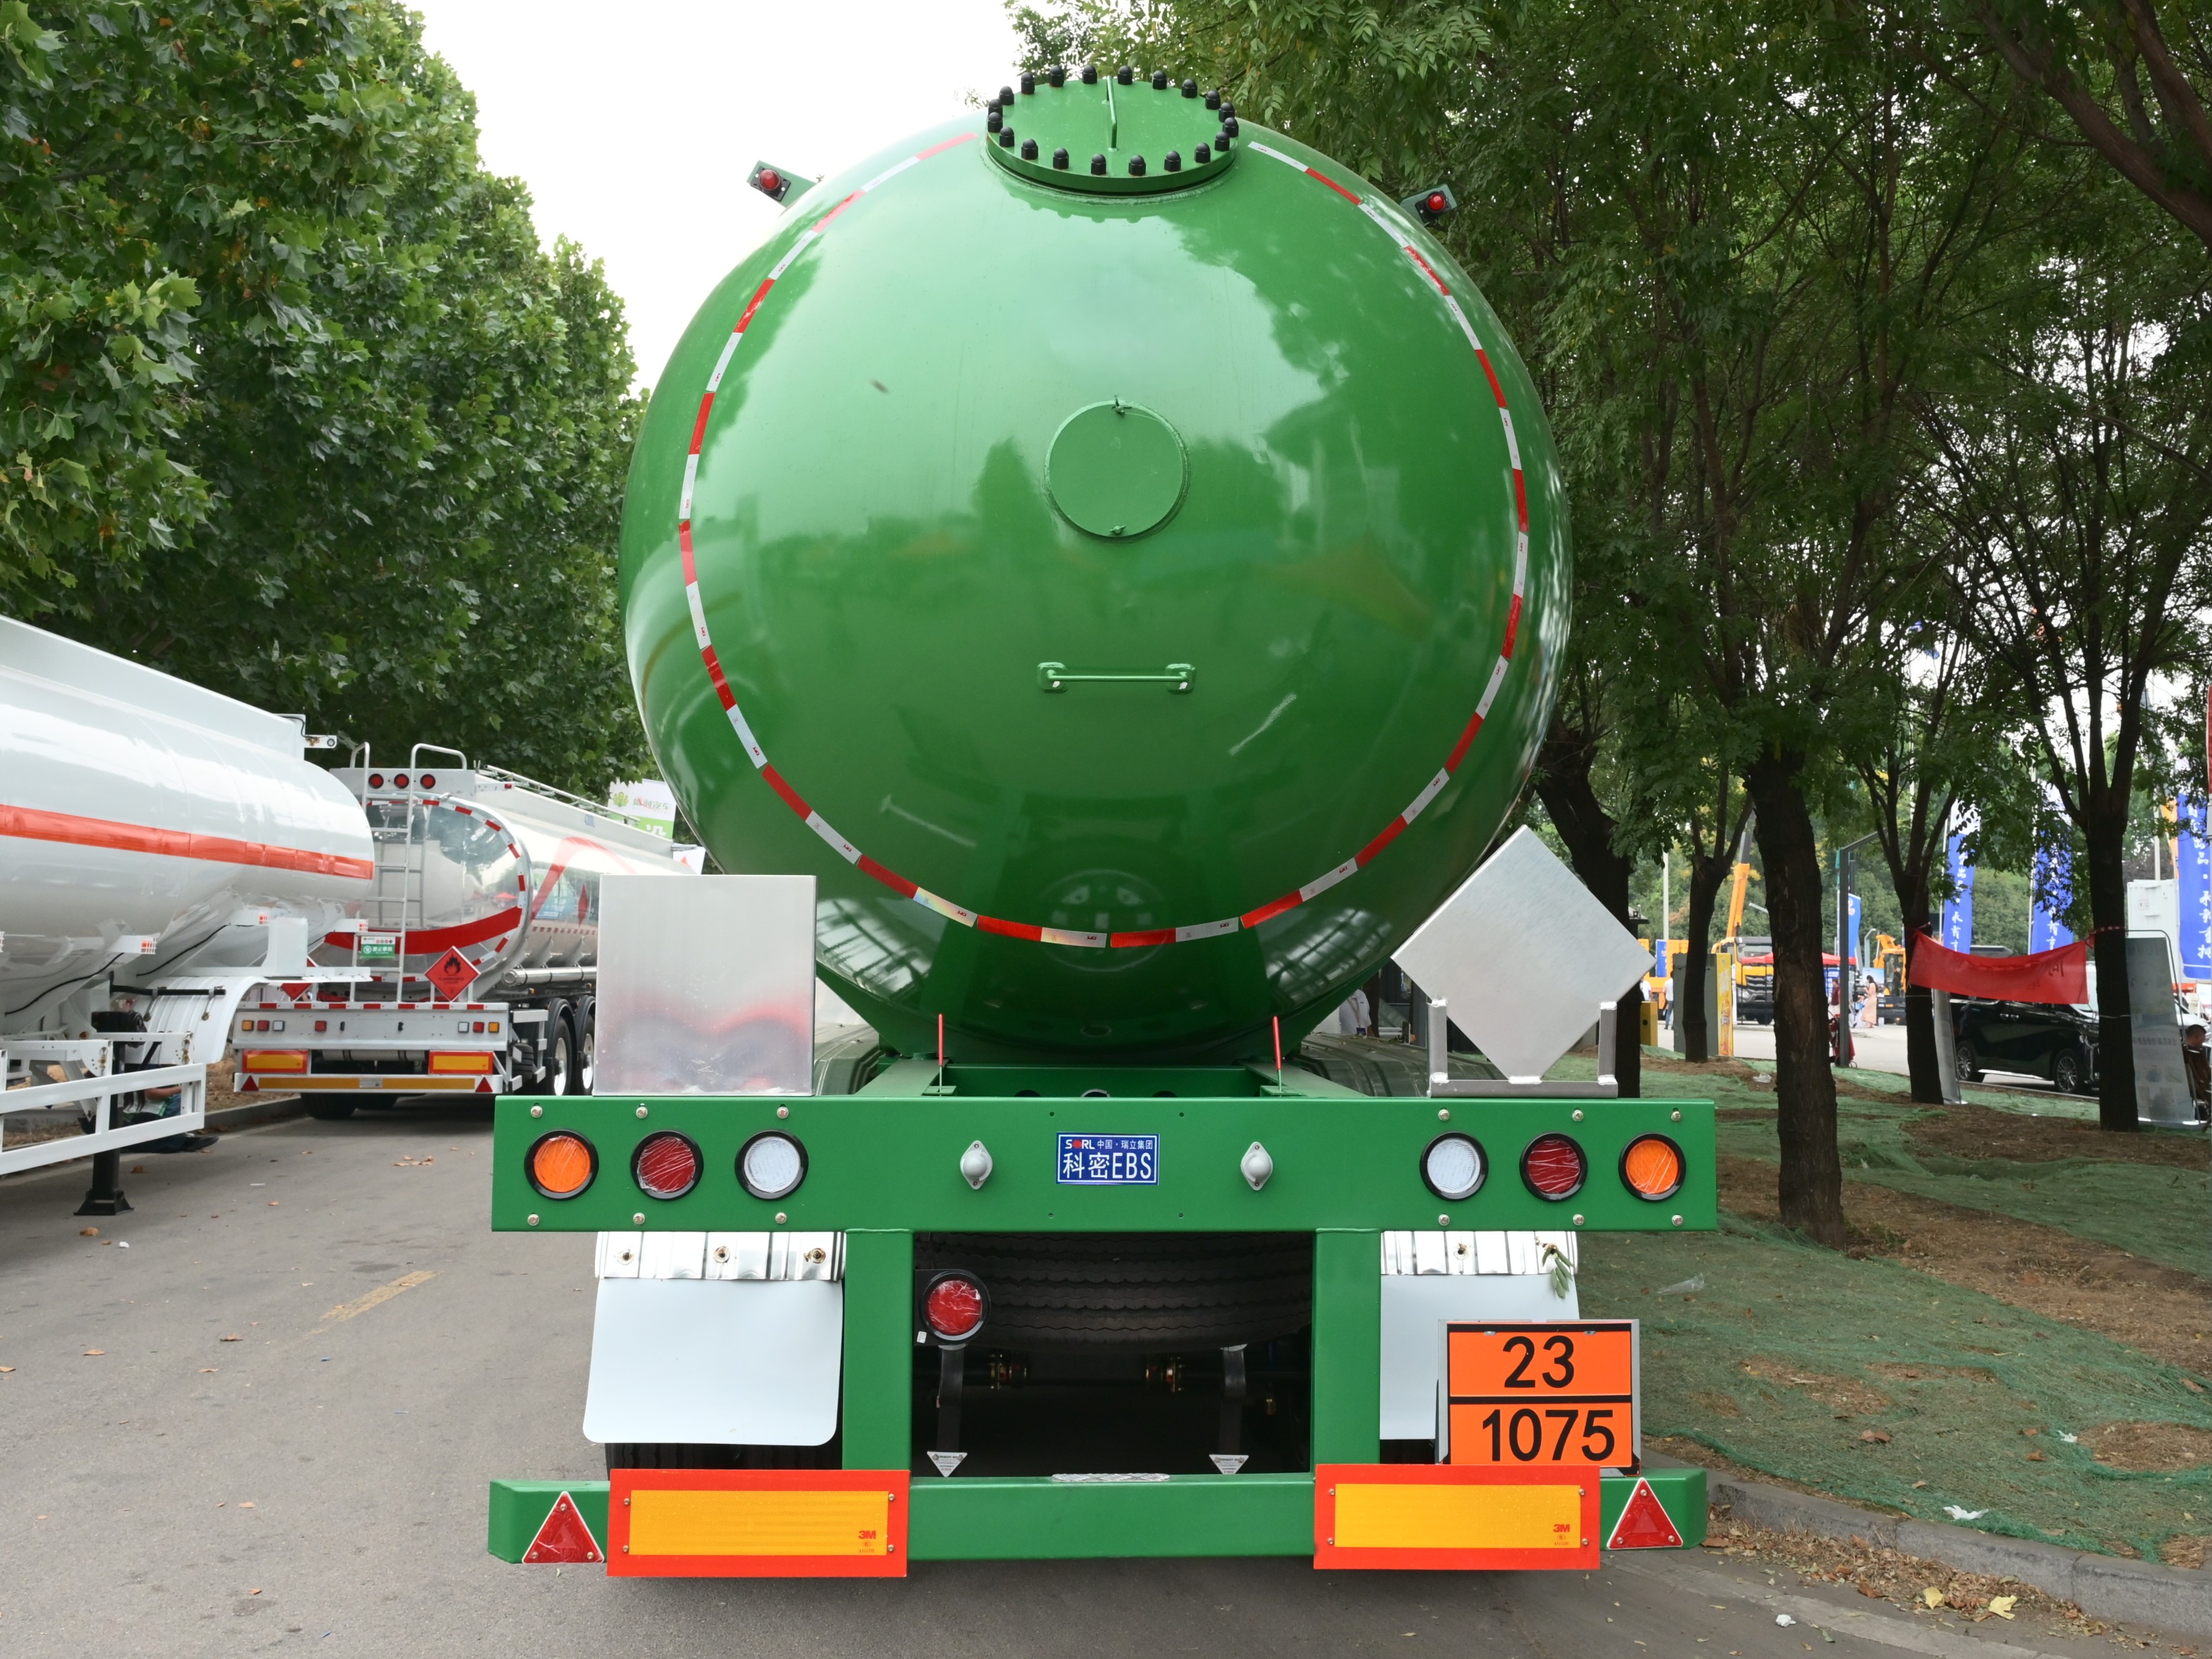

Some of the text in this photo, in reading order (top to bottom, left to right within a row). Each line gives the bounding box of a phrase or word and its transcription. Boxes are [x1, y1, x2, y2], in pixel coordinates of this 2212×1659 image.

[1502, 1335, 1575, 1389] 23
[1482, 1408, 1616, 1462] 1075
[858, 1530, 876, 1540] 3M
[1553, 1524, 1570, 1533] 3M
